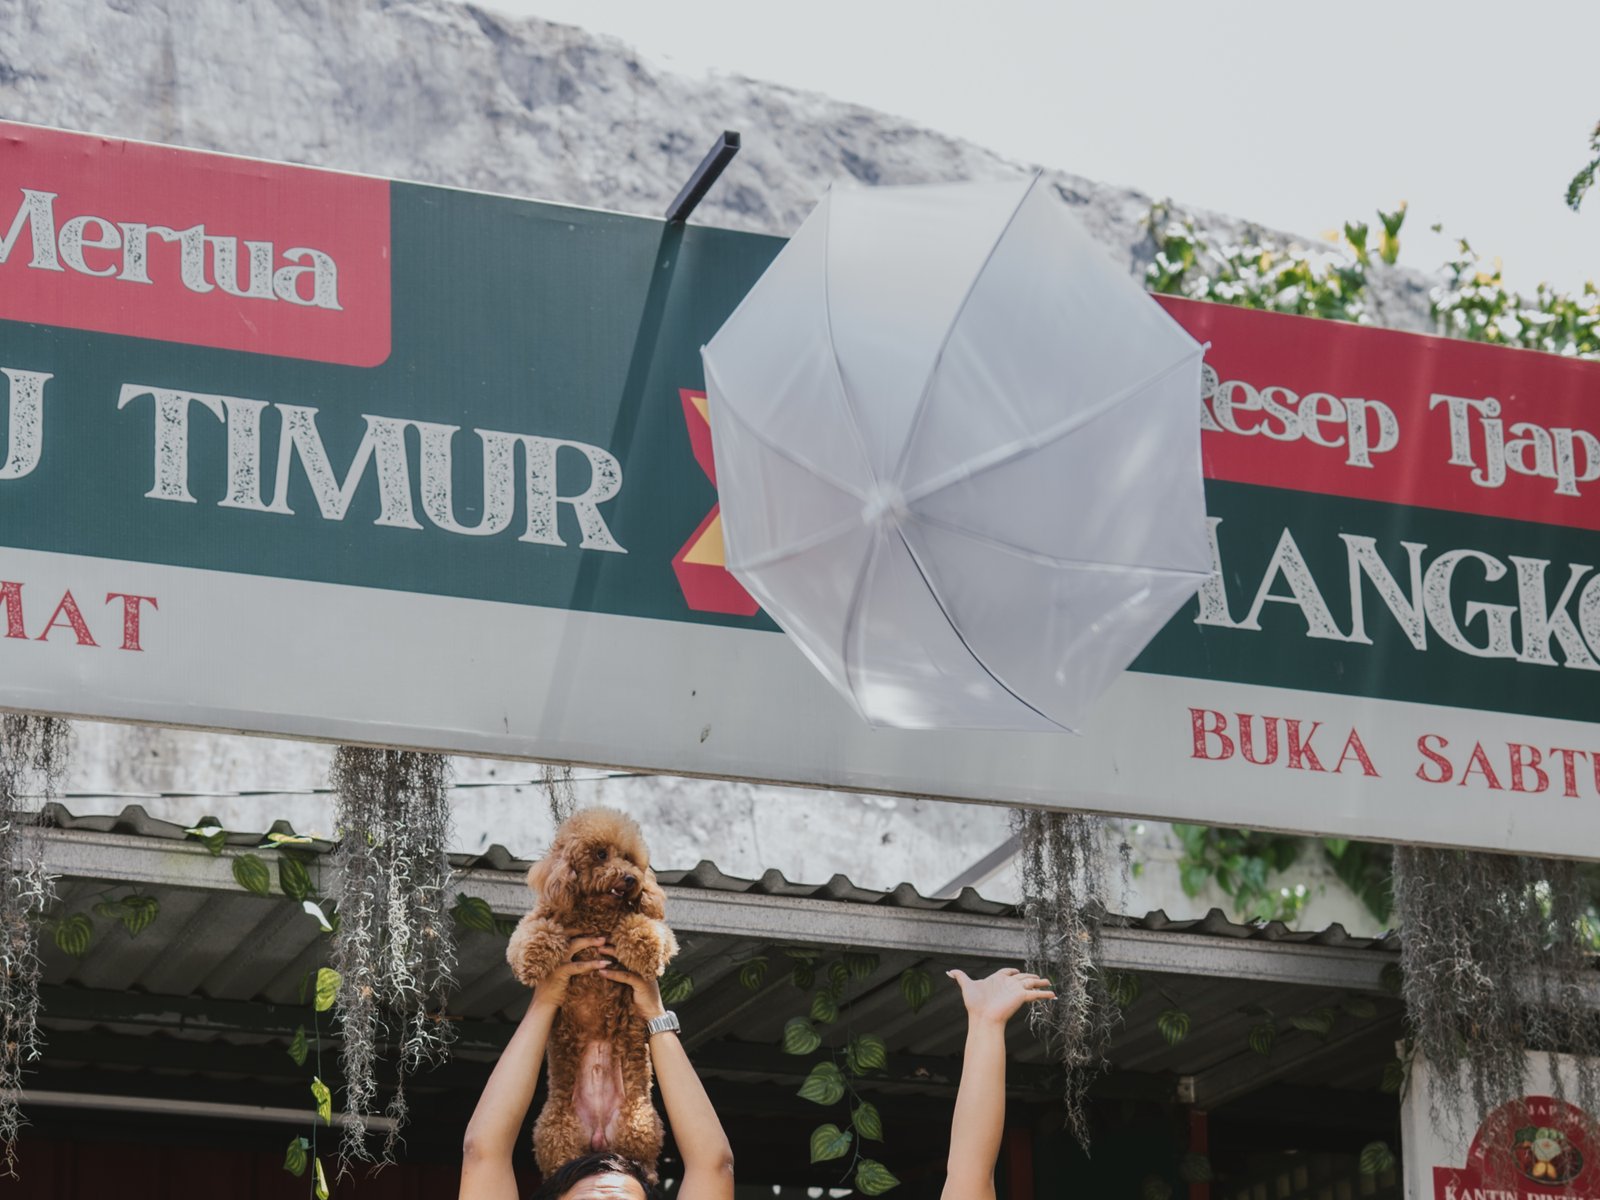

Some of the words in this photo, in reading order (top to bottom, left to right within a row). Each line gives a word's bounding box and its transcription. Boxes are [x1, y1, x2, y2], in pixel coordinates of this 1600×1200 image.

[117, 383, 628, 554] TIMUR
[1430, 392, 1600, 496] Tjap
[1188, 707, 1381, 779] BUKA
[1416, 734, 1600, 798] SABT
